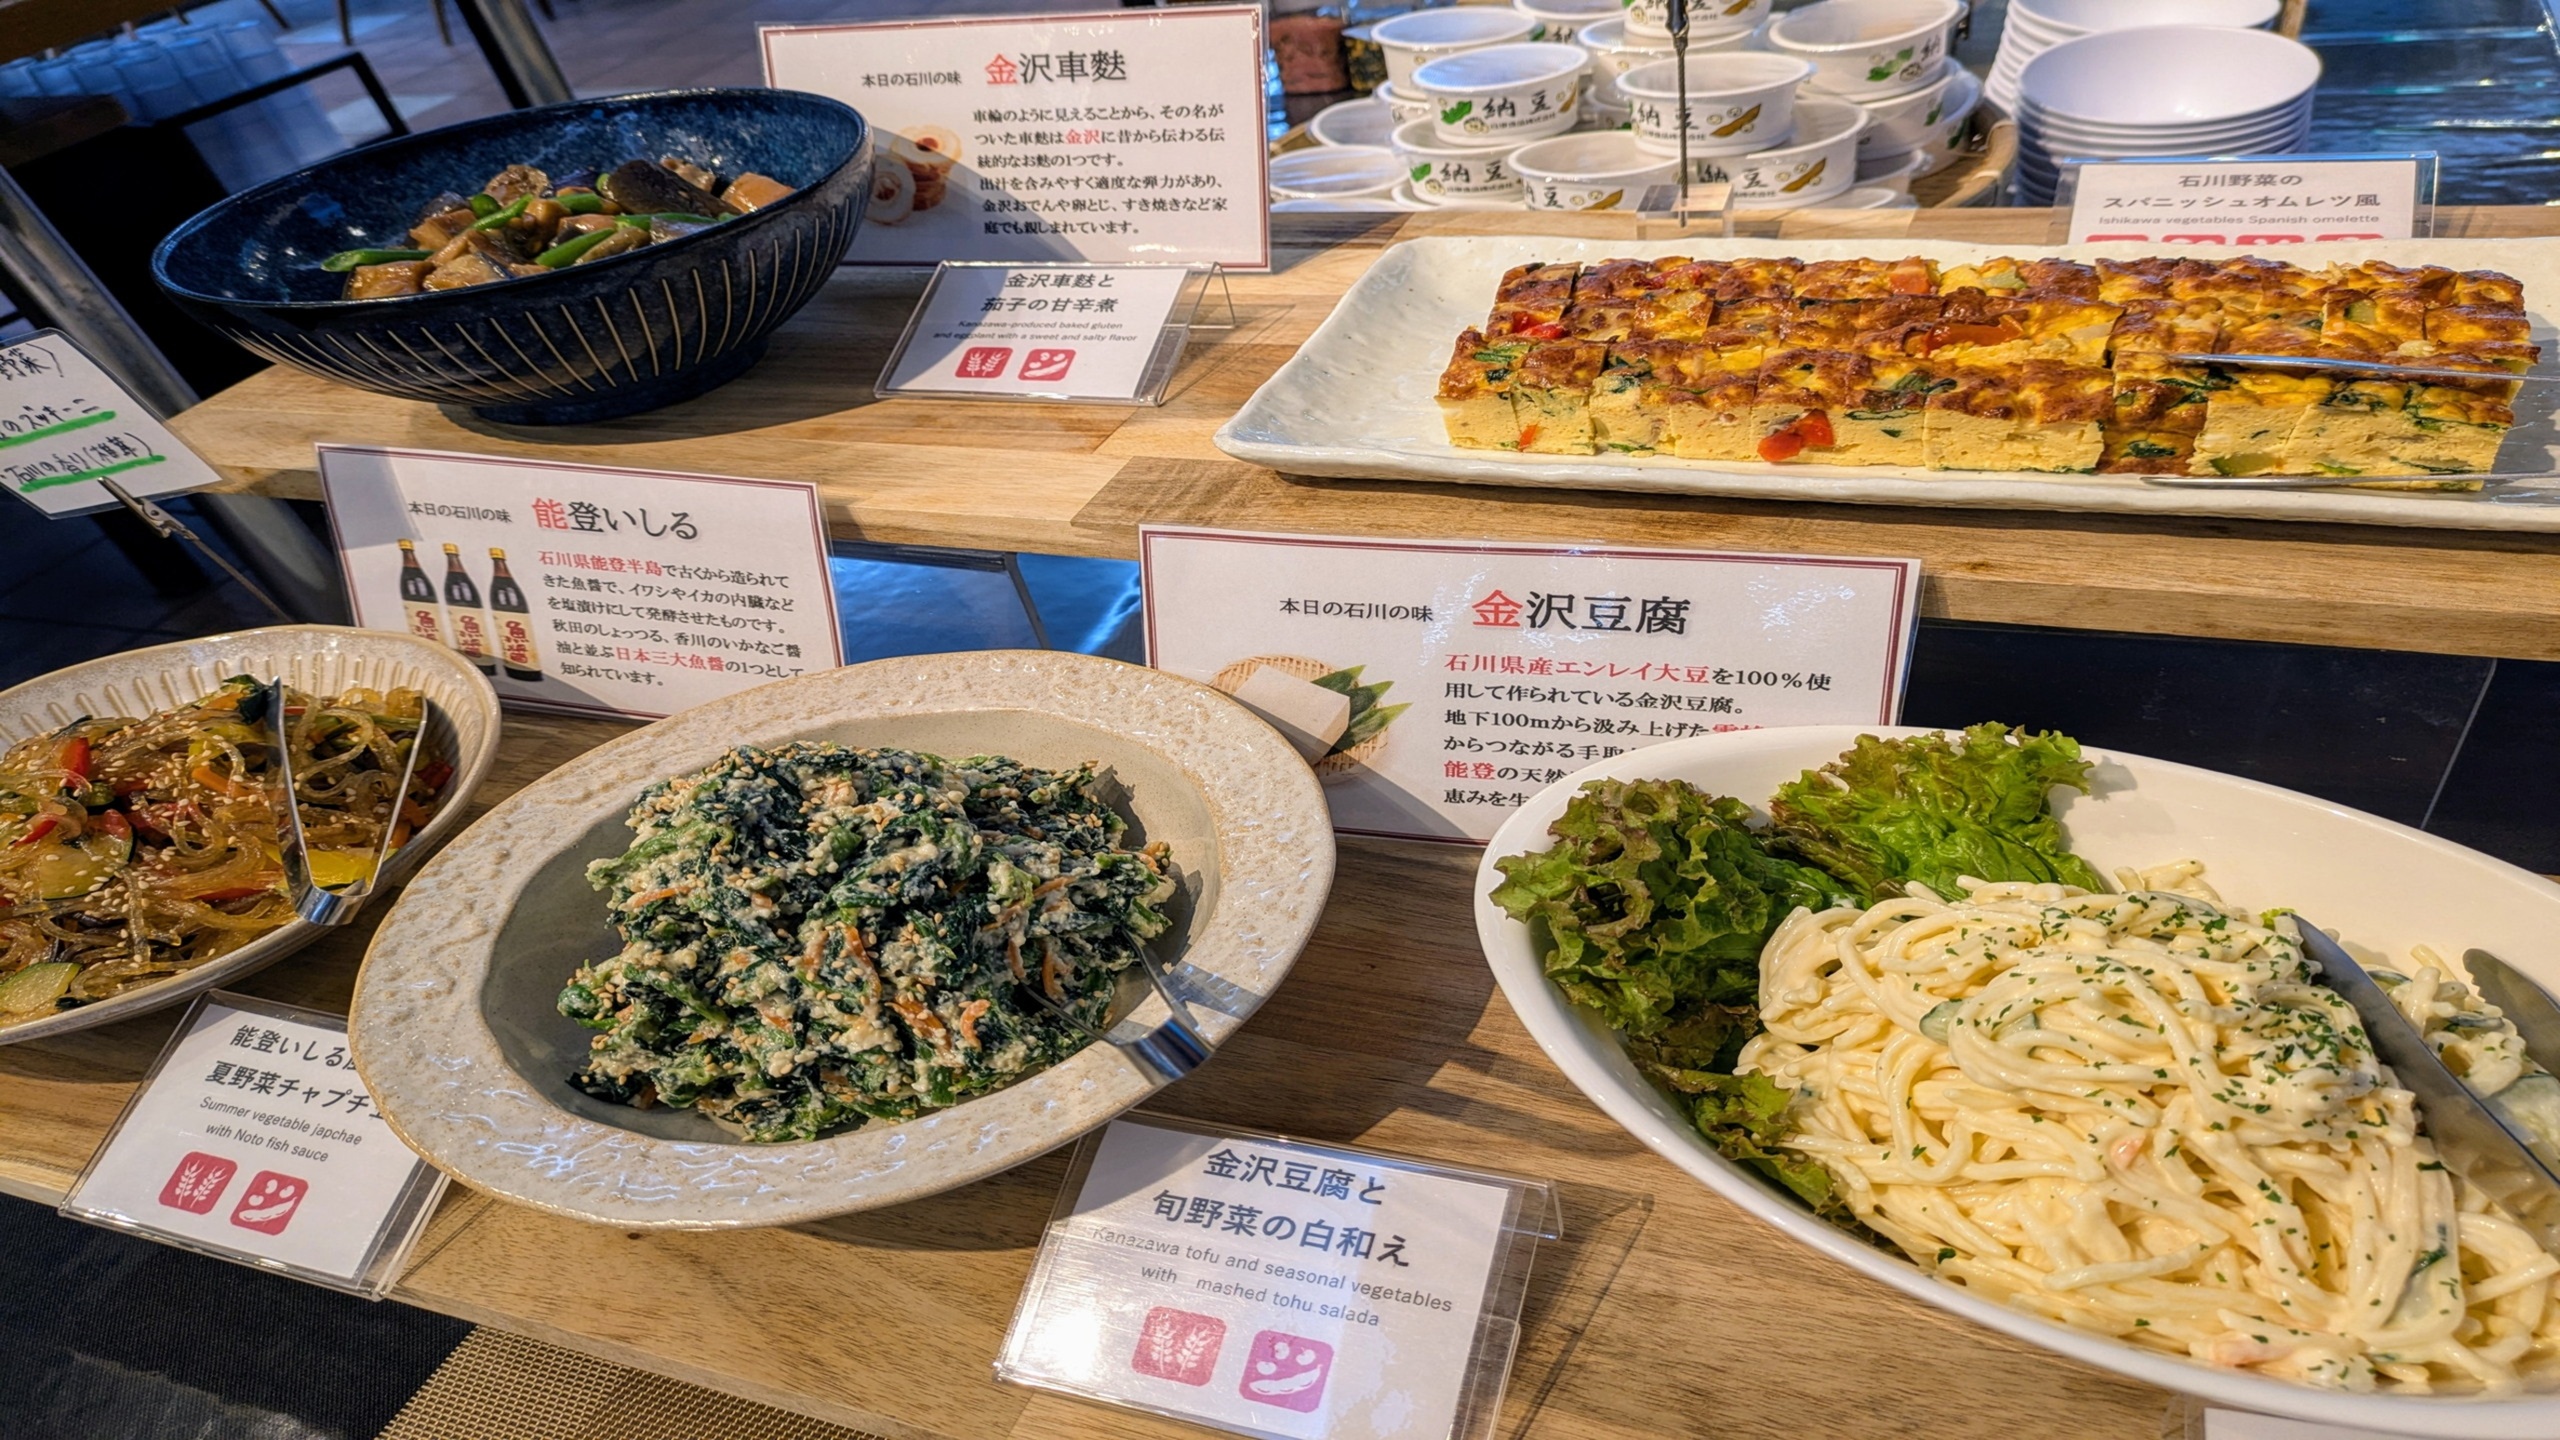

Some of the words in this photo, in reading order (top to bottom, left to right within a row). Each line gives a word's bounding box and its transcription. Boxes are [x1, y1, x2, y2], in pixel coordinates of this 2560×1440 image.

[861, 71, 962, 88] 本日の石川の味
[973, 103, 1224, 124] 車輪のように見えることから、その名が
[1482, 89, 1551, 119] 納豆
[980, 175, 1223, 192] 出汁を含みやすく適度な弾力があり、
[1440, 159, 1507, 183] 納豆
[2179, 173, 2303, 188] 石川野菜の
[982, 197, 1228, 213] 金沢おでんや卵とじ、すき焼きなど家
[984, 220, 1140, 235] 庭でも親しまれています。
[2099, 216, 2161, 225] Ishikawa
[2166, 216, 2243, 225] vegetables
[2249, 215, 2307, 225] Spanish
[2312, 214, 2379, 223] omelette
[981, 297, 1119, 313] 茄子の甘辛煮
[997, 332, 1019, 340] with
[1062, 333, 1080, 341] and
[1082, 333, 1107, 342] salty
[1109, 333, 1138, 342] flavor
[1058, 321, 1088, 329] baked
[1091, 321, 1123, 330] gluten
[408, 501, 513, 524] 本日の石川の味
[531, 497, 698, 541] 能登いしる
[538, 550, 789, 588] 石川県能登半島で古くから造られて
[548, 596, 786, 635] を塩漬けにして発酵させたものです。
[1279, 598, 1434, 623] 本日の石川の味
[1472, 588, 1691, 636] 金沢豆腐
[561, 661, 665, 687] 知られています。
[1444, 653, 1832, 692] 石川県産エンレイ大豆を100%使
[1444, 681, 1745, 715] 用して作られている金沢豆腐。
[1444, 736, 1637, 760] からつながる手取
[1444, 760, 1576, 783] 能登の天然
[200, 1096, 250, 1118] Summer
[252, 1111, 310, 1133] vegetable
[310, 1123, 362, 1146] japchae
[205, 1123, 232, 1138] with
[234, 1128, 264, 1146] Noto
[265, 1137, 289, 1153] fish
[291, 1145, 329, 1162] sauce
[1203, 1148, 1386, 1206] 金沢豆腐と
[1153, 1189, 1411, 1268] 旬野菜の白和え
[1092, 1226, 1180, 1256] Kanazawa
[1186, 1244, 1220, 1264] tofu
[1225, 1254, 1260, 1273] and
[1264, 1262, 1345, 1290] seasonal
[1351, 1278, 1452, 1313] vegetables
[1140, 1265, 1178, 1284] with
[1196, 1276, 1268, 1303] mashed
[1272, 1292, 1312, 1314] tohu
[1318, 1301, 1380, 1328] salada
